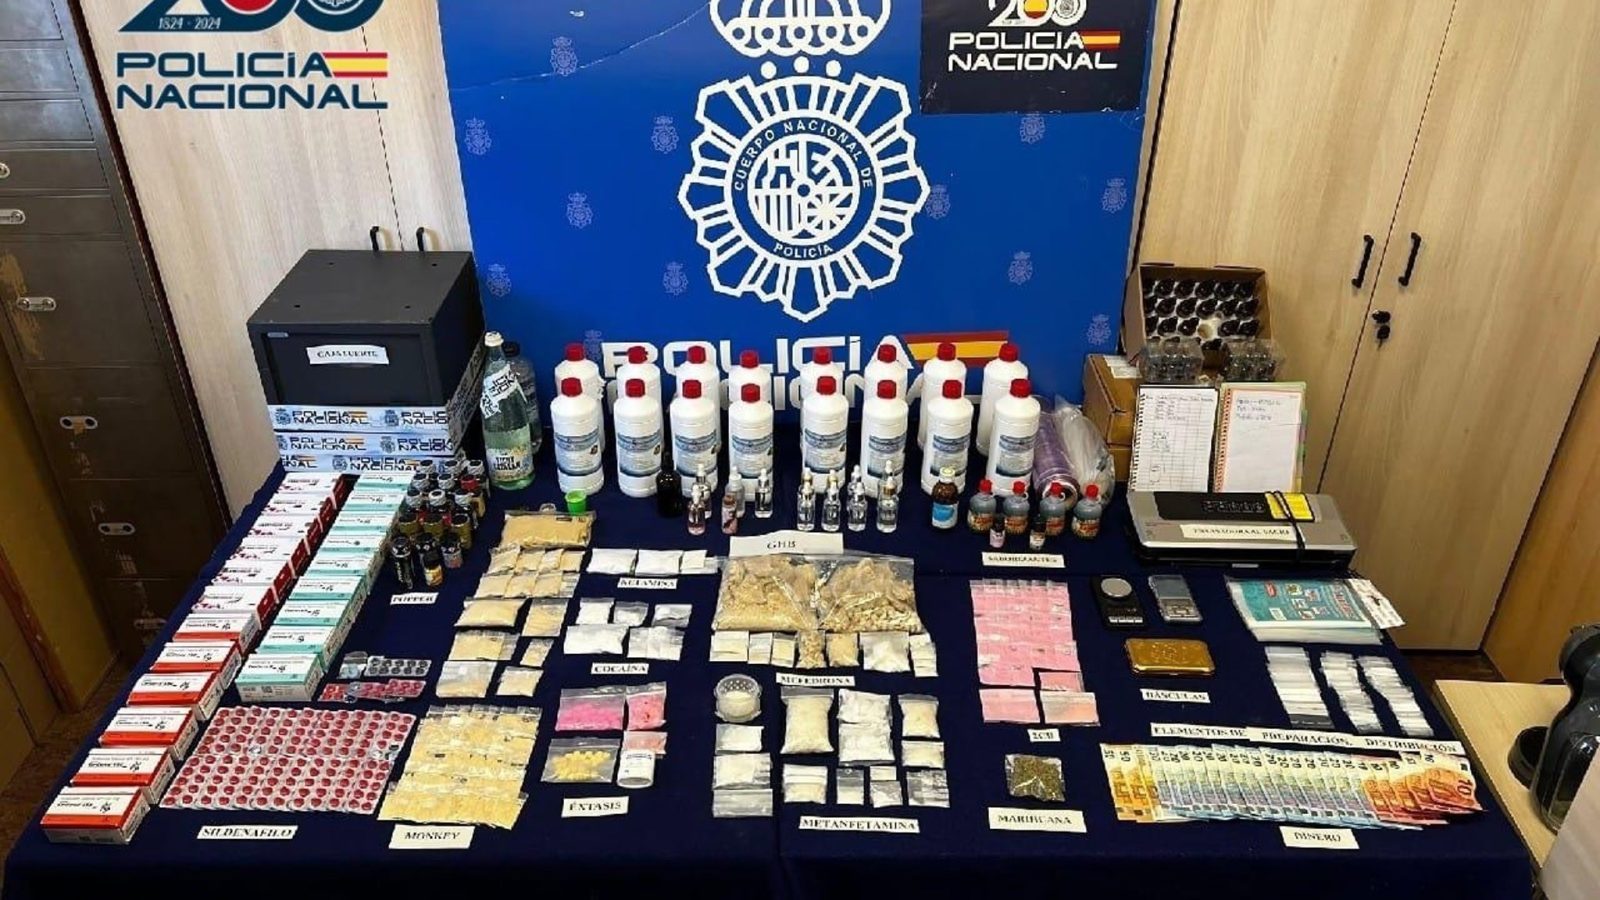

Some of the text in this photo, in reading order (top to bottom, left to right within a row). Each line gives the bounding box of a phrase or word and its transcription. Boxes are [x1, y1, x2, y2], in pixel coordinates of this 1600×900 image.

[948, 52, 1118, 71] NACIONAL
[734, 119, 874, 191] CUERPO NACIONAL DE
[773, 242, 834, 258] POLICÍA
[766, 540, 796, 550] GHB
[1153, 726, 1228, 737] ELEMENTOS
[569, 801, 621, 811] ÉXTASIS
[802, 818, 916, 830] METANFETAMINA
[404, 831, 461, 840] MONKEY
